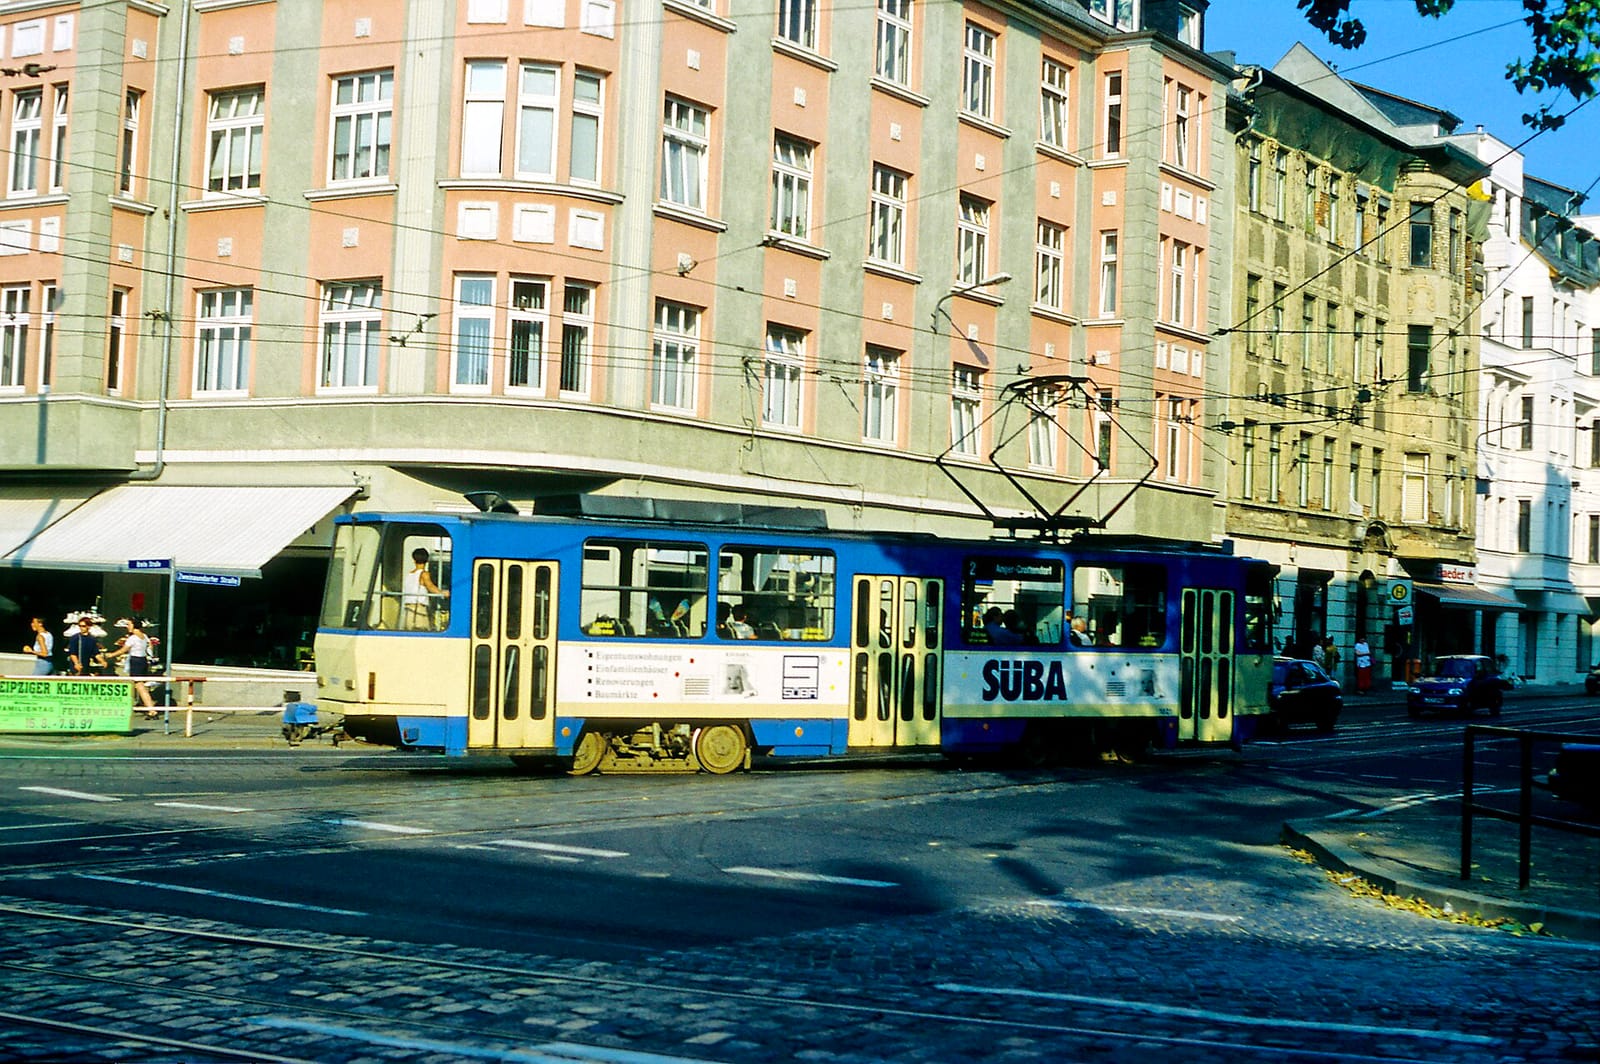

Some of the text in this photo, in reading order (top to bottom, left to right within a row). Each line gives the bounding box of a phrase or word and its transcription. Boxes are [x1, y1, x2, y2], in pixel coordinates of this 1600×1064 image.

[352, 605, 360, 622] 2
[982, 659, 1067, 701] SÜBA
[57, 682, 128, 697] KLEINMESSE
